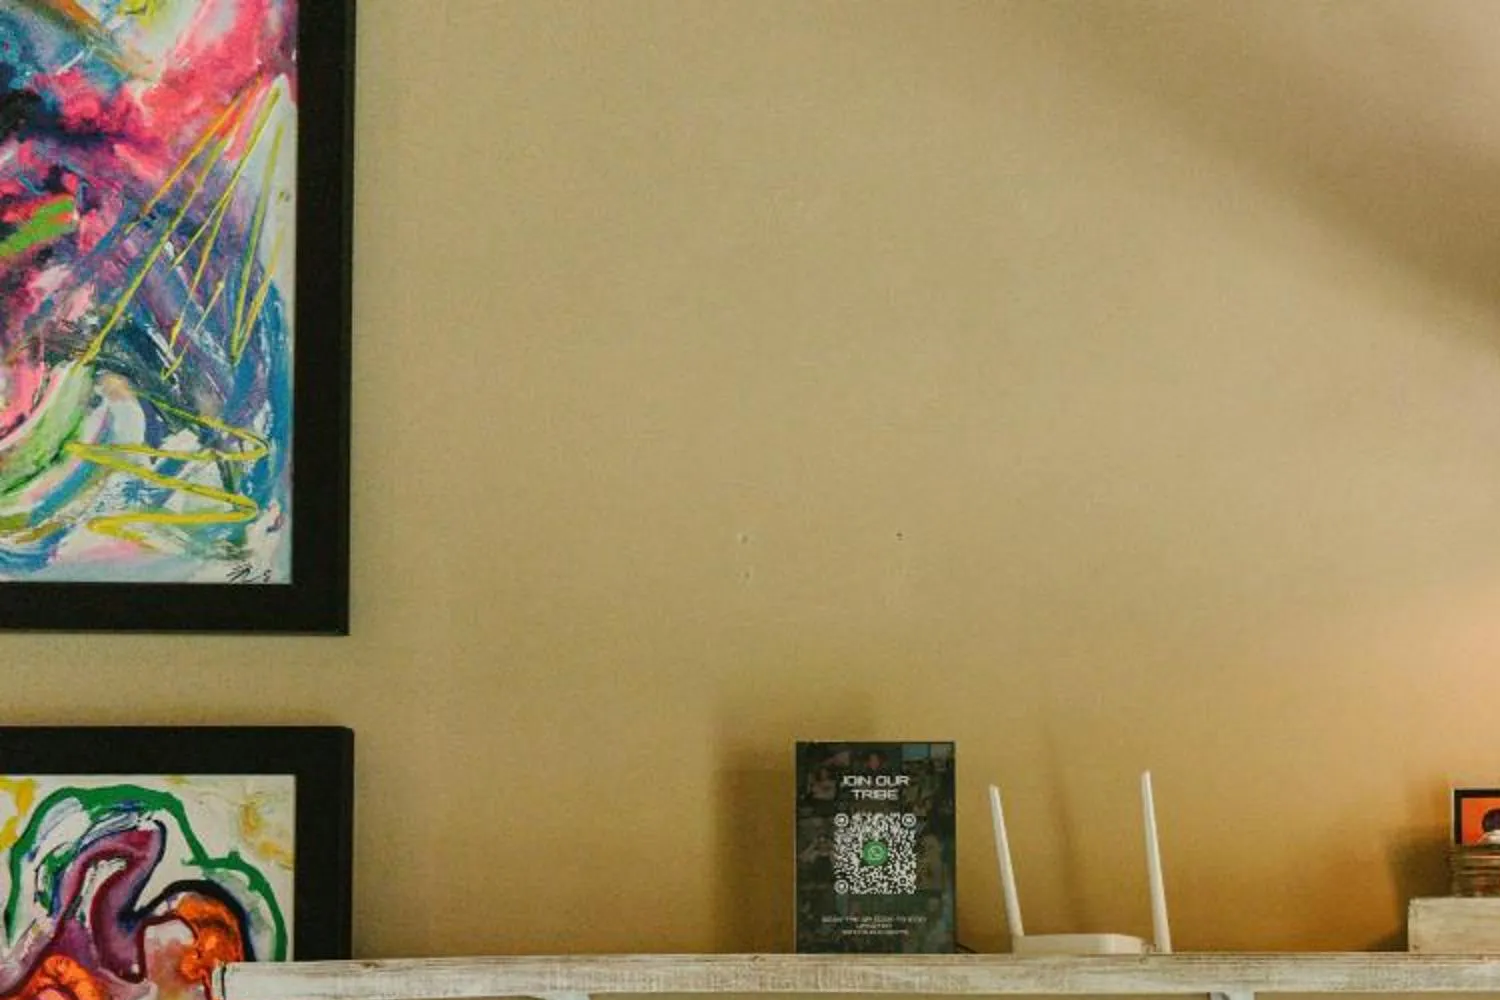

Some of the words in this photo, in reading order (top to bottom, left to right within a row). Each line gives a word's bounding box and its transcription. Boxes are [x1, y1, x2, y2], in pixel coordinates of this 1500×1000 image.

[841, 775, 871, 787] JOIN
[875, 775, 910, 786] OUR
[851, 789, 899, 800] TRIBE
